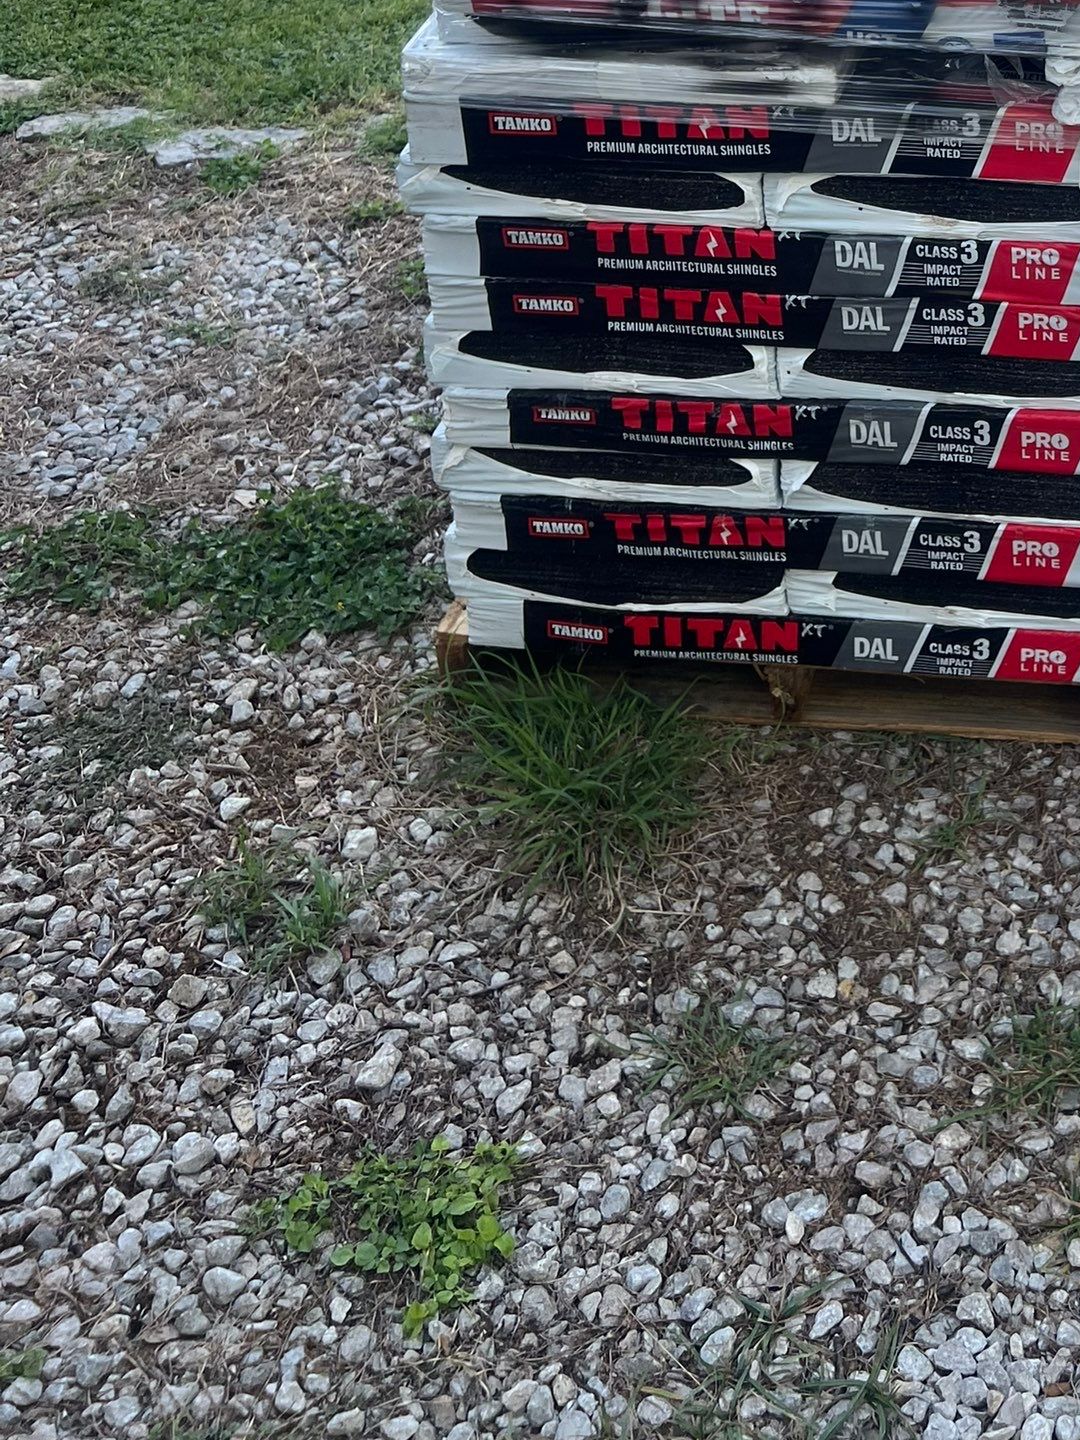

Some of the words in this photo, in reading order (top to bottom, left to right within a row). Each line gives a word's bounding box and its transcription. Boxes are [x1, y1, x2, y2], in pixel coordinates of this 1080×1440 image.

[493, 115, 552, 133] TAMKO
[573, 103, 771, 140] TITAN
[831, 117, 882, 143] DAL
[962, 112, 981, 137] 3
[1015, 121, 1063, 140] PRO
[587, 141, 636, 155] PREMIUM
[637, 142, 719, 157] ARCHITECTURAL
[719, 143, 771, 157] SHINGLES
[923, 137, 963, 148] IMPACT
[1015, 141, 1064, 154] LINE
[926, 147, 961, 159] RATED
[507, 230, 564, 246] TAMKO
[586, 222, 776, 260] TITAN
[777, 230, 802, 242] XT
[834, 240, 884, 271] DAL
[915, 243, 959, 260] CLASS
[960, 240, 978, 265] 3
[1011, 247, 1060, 266] PRO
[597, 257, 644, 271] PREMIUM
[645, 258, 726, 274] ARCHITECTURAL
[726, 263, 778, 277] SHINGLES
[923, 264, 962, 276] IMPACT
[1011, 266, 1061, 280] LINE
[926, 276, 960, 287] RATED
[518, 297, 574, 313] TAMKO
[595, 285, 784, 326] TITAN
[785, 295, 811, 310] XT
[922, 307, 965, 322] CLASS
[966, 302, 986, 327] 3
[841, 306, 891, 333] DAL
[1018, 313, 1068, 332] PRO
[607, 321, 654, 333] PREMIUM
[655, 322, 734, 338] ARCHITECTURAL
[735, 327, 785, 341] SHINGLES
[930, 325, 969, 336] IMPACT
[1018, 330, 1069, 343] LINE
[933, 335, 967, 346] RATED
[537, 406, 591, 422] TAMKO
[611, 397, 794, 437] TITAN
[795, 405, 818, 420] XT
[622, 432, 670, 445] PREMIUM
[670, 435, 746, 450] ARCHITECTURAL
[747, 438, 794, 451] SHINGLES
[849, 420, 897, 448] DAL
[929, 425, 971, 440] CLASS
[973, 420, 991, 446] 3
[1020, 431, 1070, 450] PRO
[936, 442, 975, 454] IMPACT
[1021, 448, 1070, 462] LINE
[939, 453, 973, 464] RATED
[532, 519, 585, 535] TAMKO
[604, 513, 786, 548] TITAN
[787, 517, 809, 530] XT
[841, 529, 889, 556] DAL
[919, 533, 961, 548] CLASS
[963, 531, 981, 553] 3
[1012, 540, 1060, 558] PRO
[617, 544, 662, 557] PREMIUM
[662, 546, 739, 560] ARCHITECTURAL
[740, 550, 787, 562] SHINGLES
[927, 550, 966, 561] IMPACT
[1012, 556, 1061, 569] LINE
[930, 561, 964, 571] RATED
[551, 623, 604, 641] TAMKO
[624, 615, 798, 651] TITAN
[801, 622, 827, 638] XT
[633, 649, 678, 660] PREMIUM
[678, 651, 752, 662] ARCHITECTURAL
[752, 653, 798, 664] SHINGLES
[853, 636, 899, 662] DAL
[929, 641, 971, 656] CLASS
[972, 638, 990, 661] 3
[1020, 647, 1067, 665] PRO
[936, 658, 974, 668] IMPACT
[939, 666, 972, 676] RATED
[1020, 663, 1067, 674] LINE
